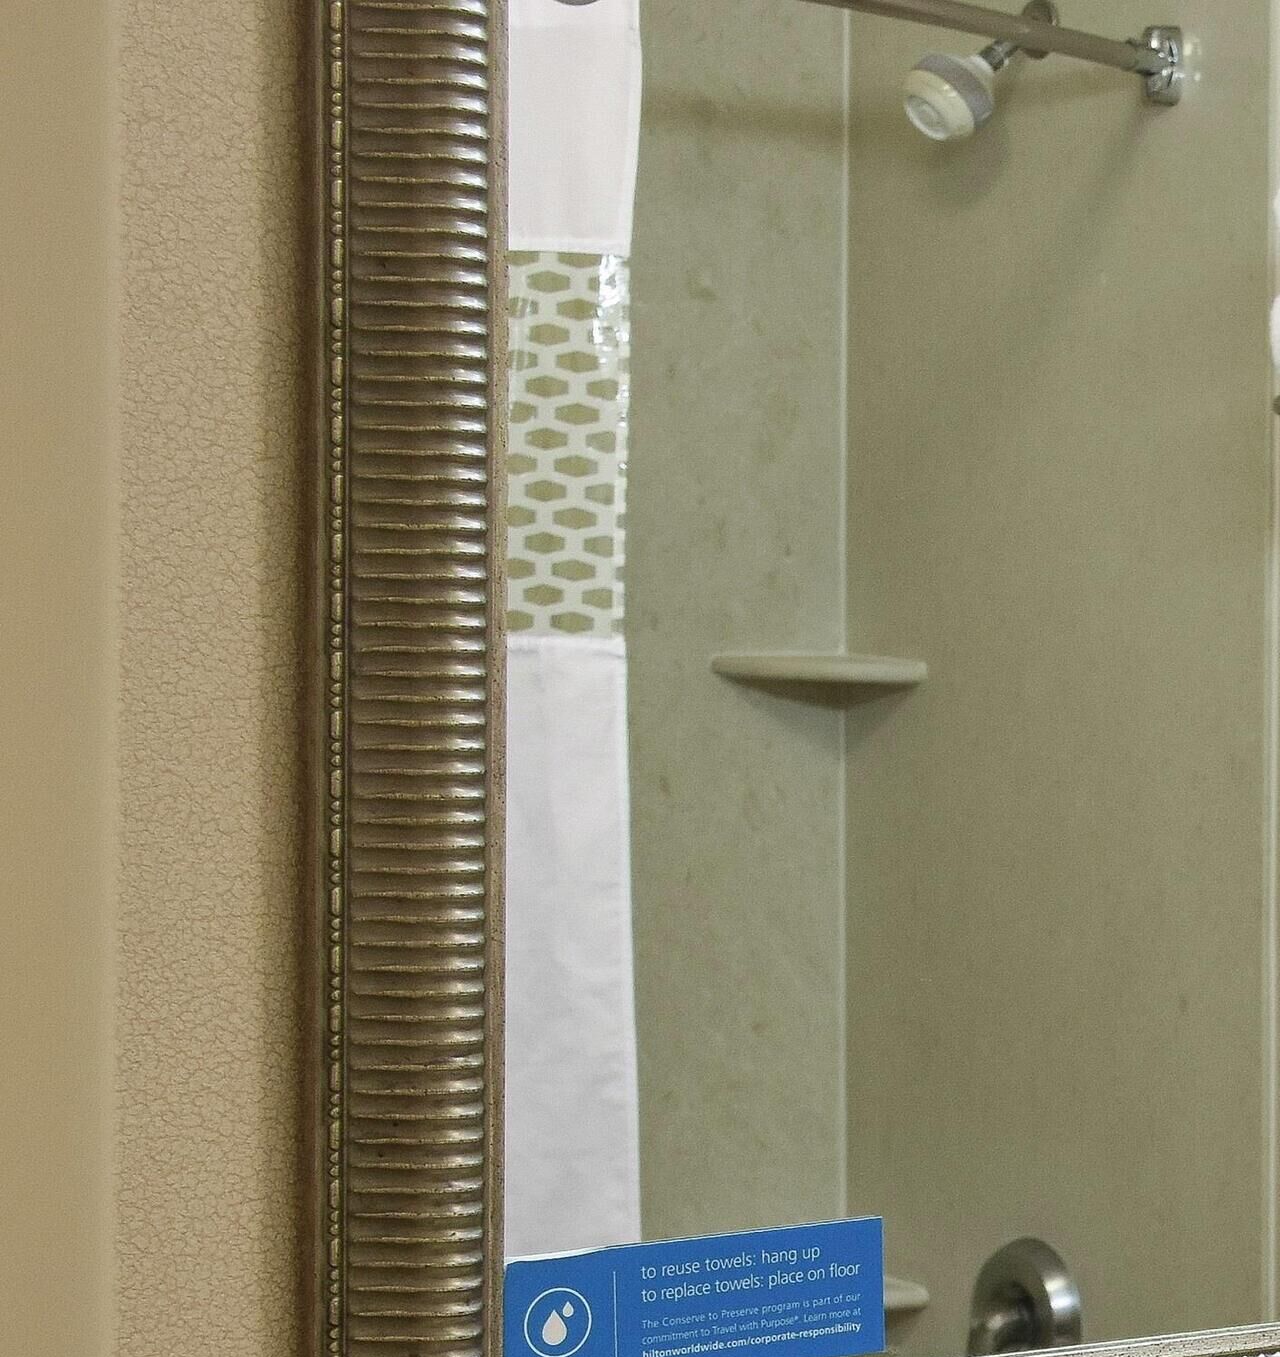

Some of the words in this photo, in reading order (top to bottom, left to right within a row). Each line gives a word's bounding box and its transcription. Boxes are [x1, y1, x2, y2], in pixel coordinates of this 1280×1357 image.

[641, 1266, 656, 1279] to
[662, 1262, 700, 1276] reuse
[705, 1252, 756, 1271] towels:
[762, 1250, 797, 1264] hang
[802, 1246, 820, 1261] up
[641, 1289, 656, 1302] to
[661, 1282, 711, 1303] replace
[715, 1274, 764, 1292] towels:
[768, 1270, 804, 1289] place
[807, 1268, 825, 1281] on
[830, 1262, 860, 1278] floor
[642, 1319, 660, 1329] The
[662, 1313, 706, 1327] Conserve
[708, 1312, 718, 1321] to
[721, 1307, 759, 1319] Preserve
[762, 1300, 800, 1316] program
[803, 1300, 809, 1308] is
[813, 1296, 831, 1308] part
[834, 1295, 842, 1304] of
[846, 1293, 861, 1302] our
[642, 1330, 698, 1345] commitment
[700, 1327, 711, 1337] to
[712, 1323, 737, 1335] Travel
[739, 1320, 758, 1331] with
[804, 1313, 827, 1323] Learn
[829, 1308, 850, 1319] more
[852, 1307, 862, 1316] at
